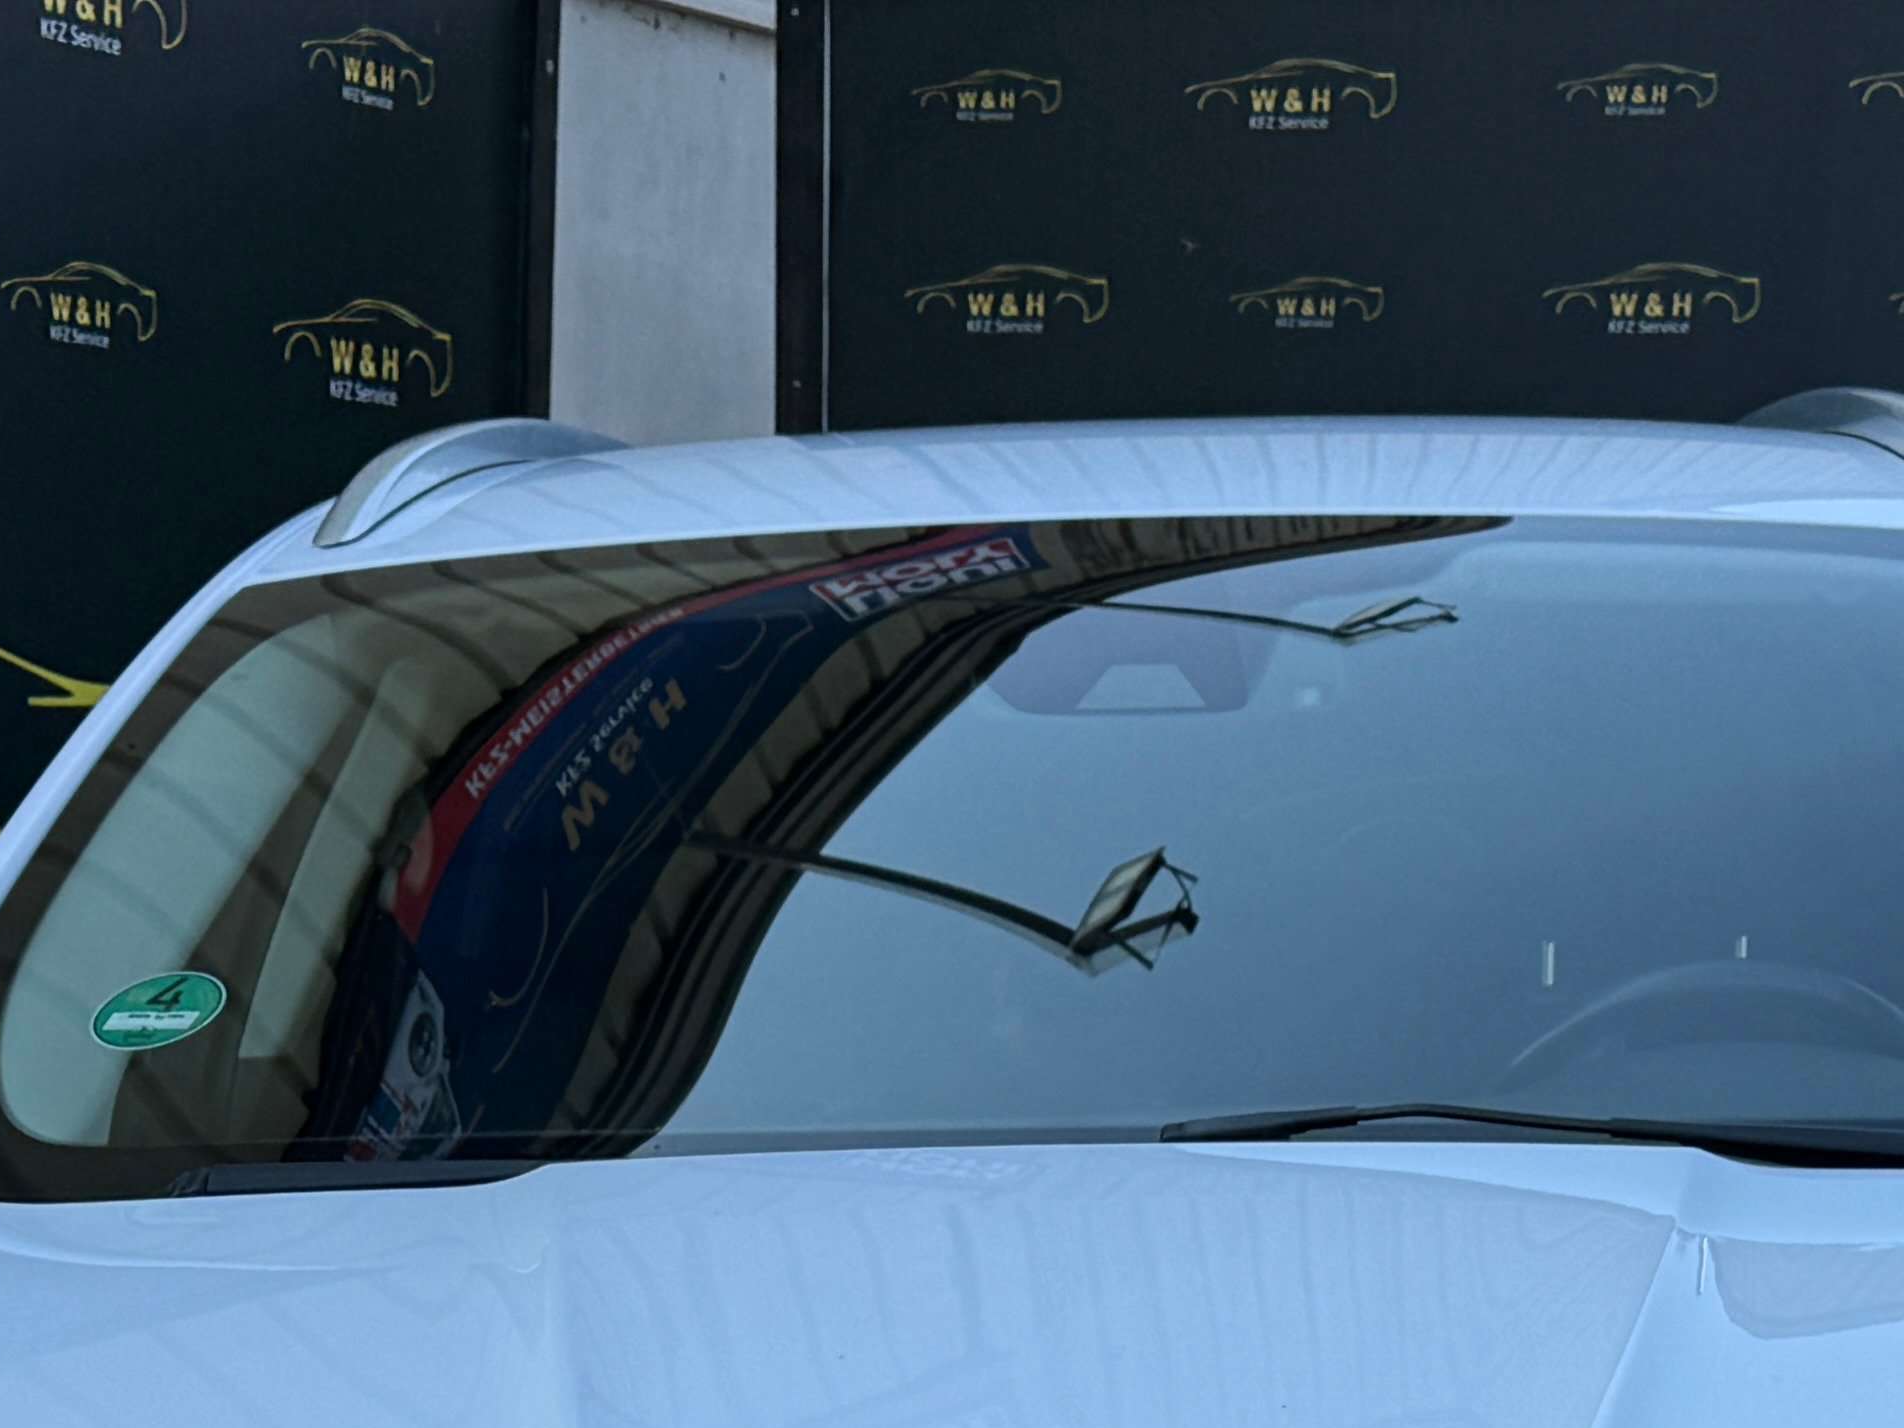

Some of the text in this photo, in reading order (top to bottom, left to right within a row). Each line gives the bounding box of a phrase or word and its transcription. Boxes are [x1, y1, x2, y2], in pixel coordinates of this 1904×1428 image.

[343, 57, 395, 92] W & H
[957, 90, 1016, 110] W & H
[1250, 88, 1331, 113] W & H
[1606, 84, 1668, 105] W & H
[50, 293, 111, 329] W & H
[968, 293, 1044, 317] W & H
[1277, 297, 1337, 317] W & H
[1610, 292, 1692, 317] W & H
[330, 339, 399, 381] W & H
[145, 975, 190, 1013] 4
